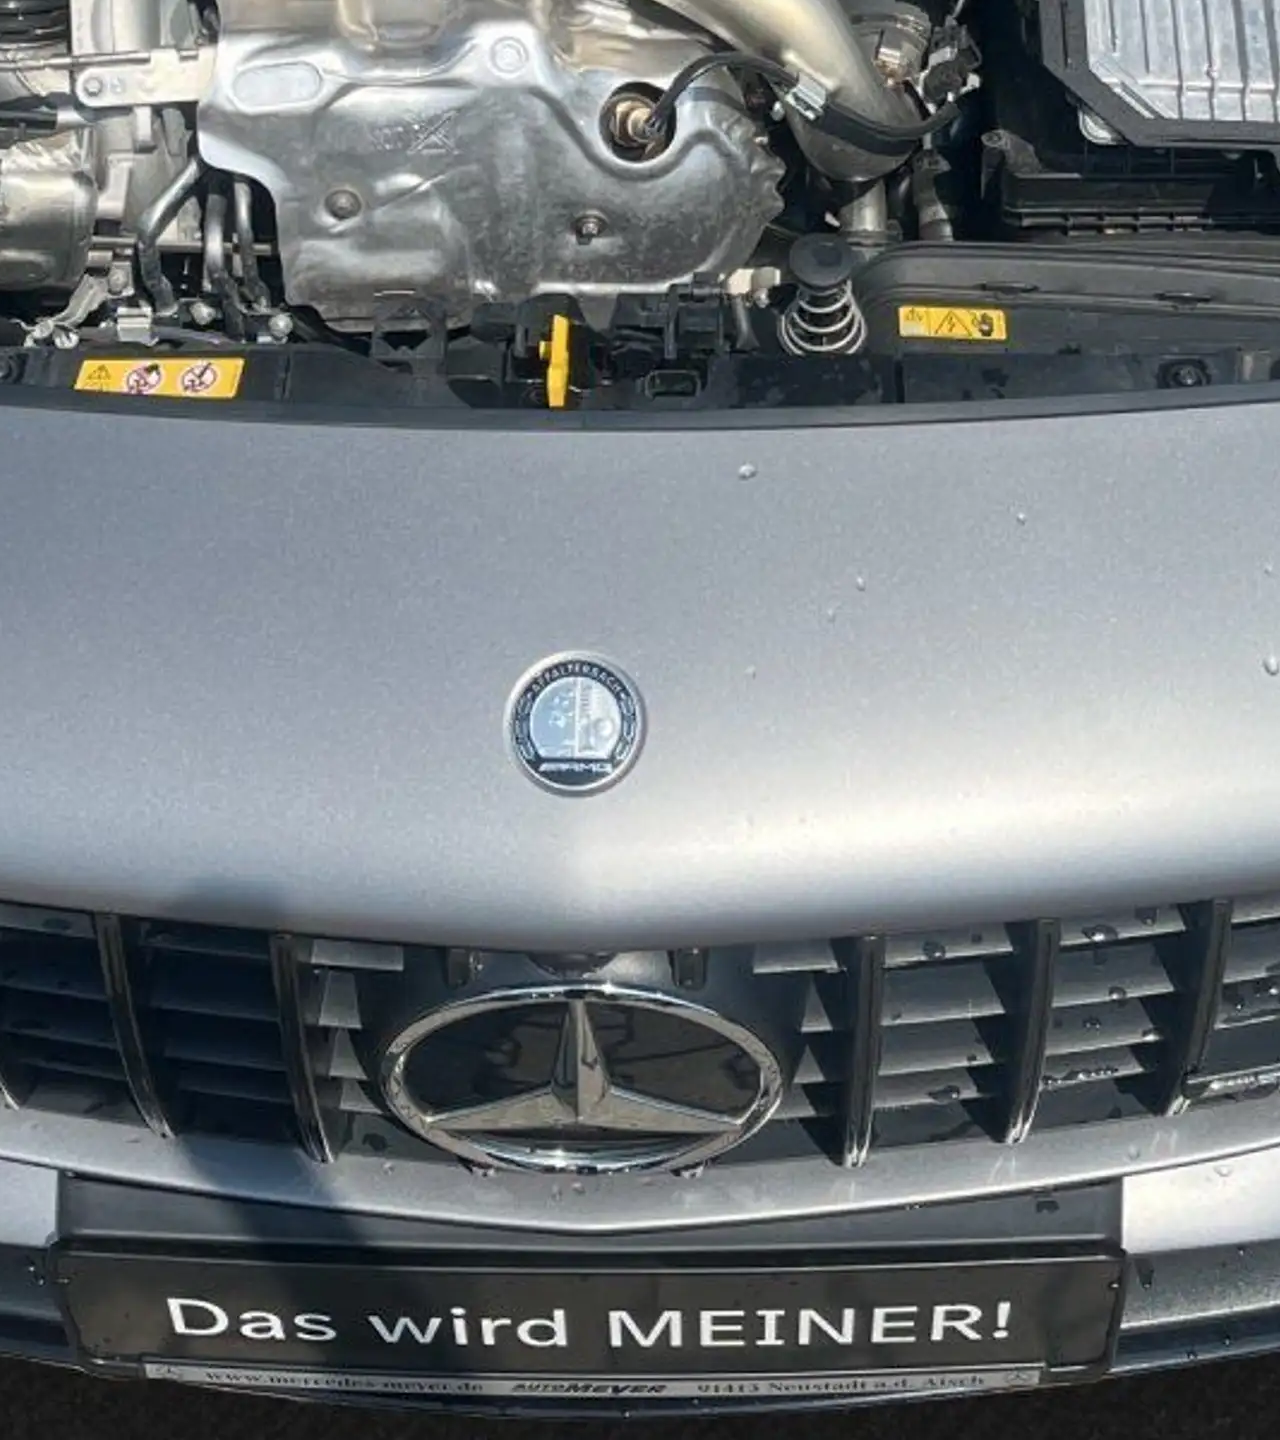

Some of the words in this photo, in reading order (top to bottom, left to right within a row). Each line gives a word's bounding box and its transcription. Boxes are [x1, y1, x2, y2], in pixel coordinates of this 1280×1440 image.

[530, 662, 623, 694] AFFALTERBACH
[166, 1297, 338, 1342] Das
[368, 1307, 568, 1347] wird
[607, 1301, 1012, 1348] MEINER!
[768, 1378, 866, 1393] Neustadt
[926, 1374, 985, 1387] Aisch
